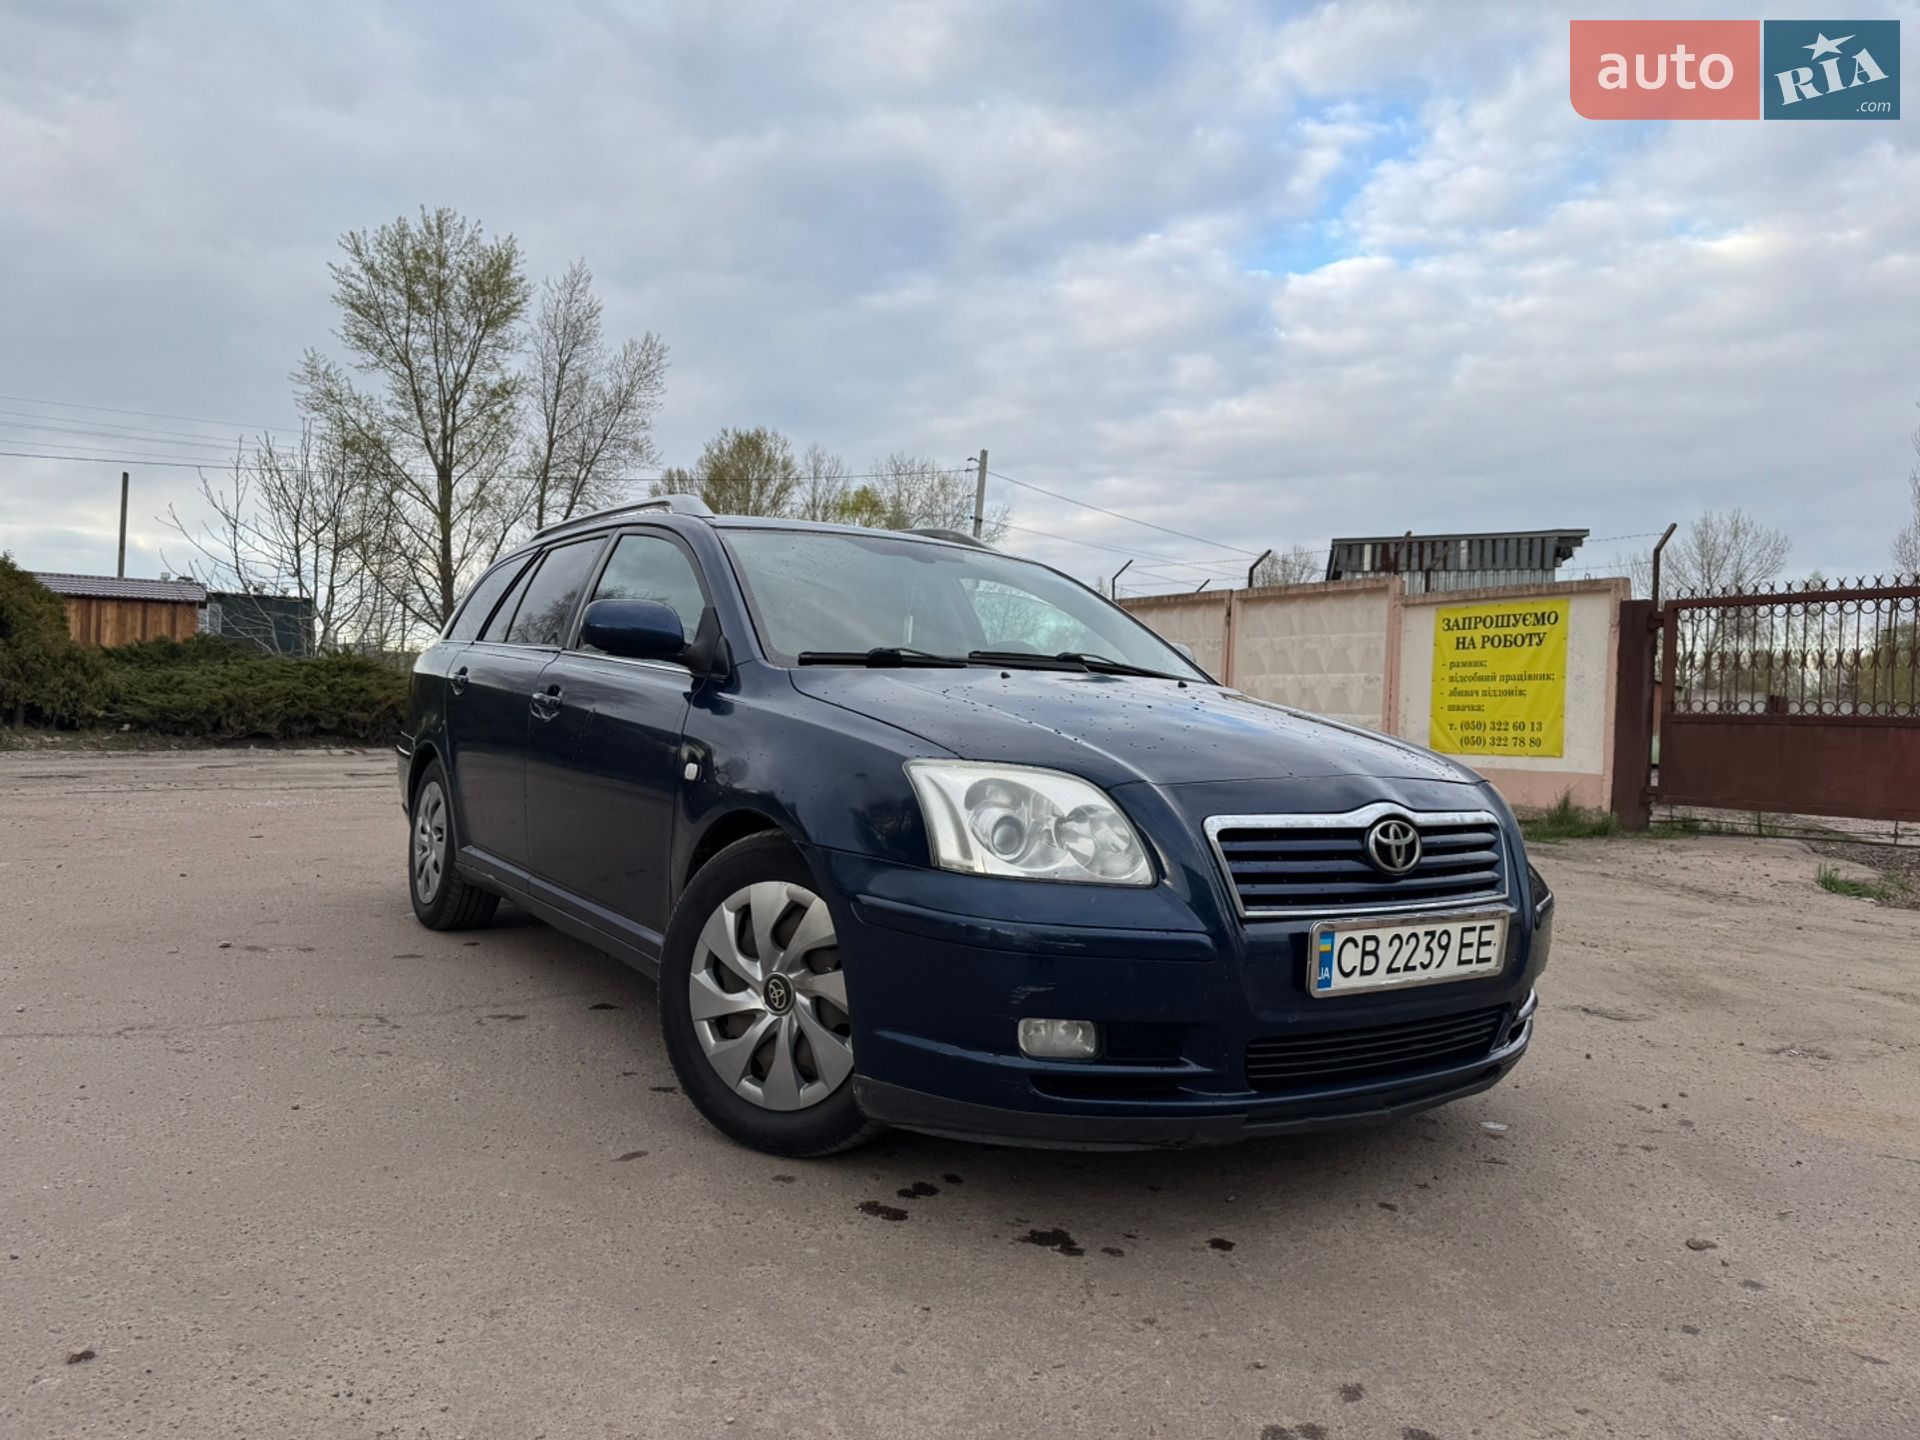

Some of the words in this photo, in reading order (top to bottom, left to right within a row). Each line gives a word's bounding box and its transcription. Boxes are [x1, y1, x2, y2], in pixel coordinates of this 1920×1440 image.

[1442, 610, 1559, 631] ЗАПРОШУЄМО
[1455, 636, 1476, 650] НА
[1481, 632, 1547, 649] РОБОТУ
[1448, 672, 1497, 683] підсобний
[1499, 671, 1555, 683] працівник;
[1448, 687, 1479, 697] збивач
[1481, 686, 1527, 697] піддонів;
[1447, 704, 1485, 712] швачка;
[1460, 721, 1486, 733] (050)
[1489, 721, 1509, 731] 322
[1512, 721, 1526, 731] 60
[1529, 721, 1543, 732] 13
[1460, 736, 1486, 748] (050)
[1489, 736, 1509, 747] 322
[1512, 736, 1526, 747] 78
[1529, 736, 1542, 747] 80
[1337, 934, 1380, 978] CB
[1386, 929, 1451, 974] 2239
[1457, 925, 1495, 966] EE
